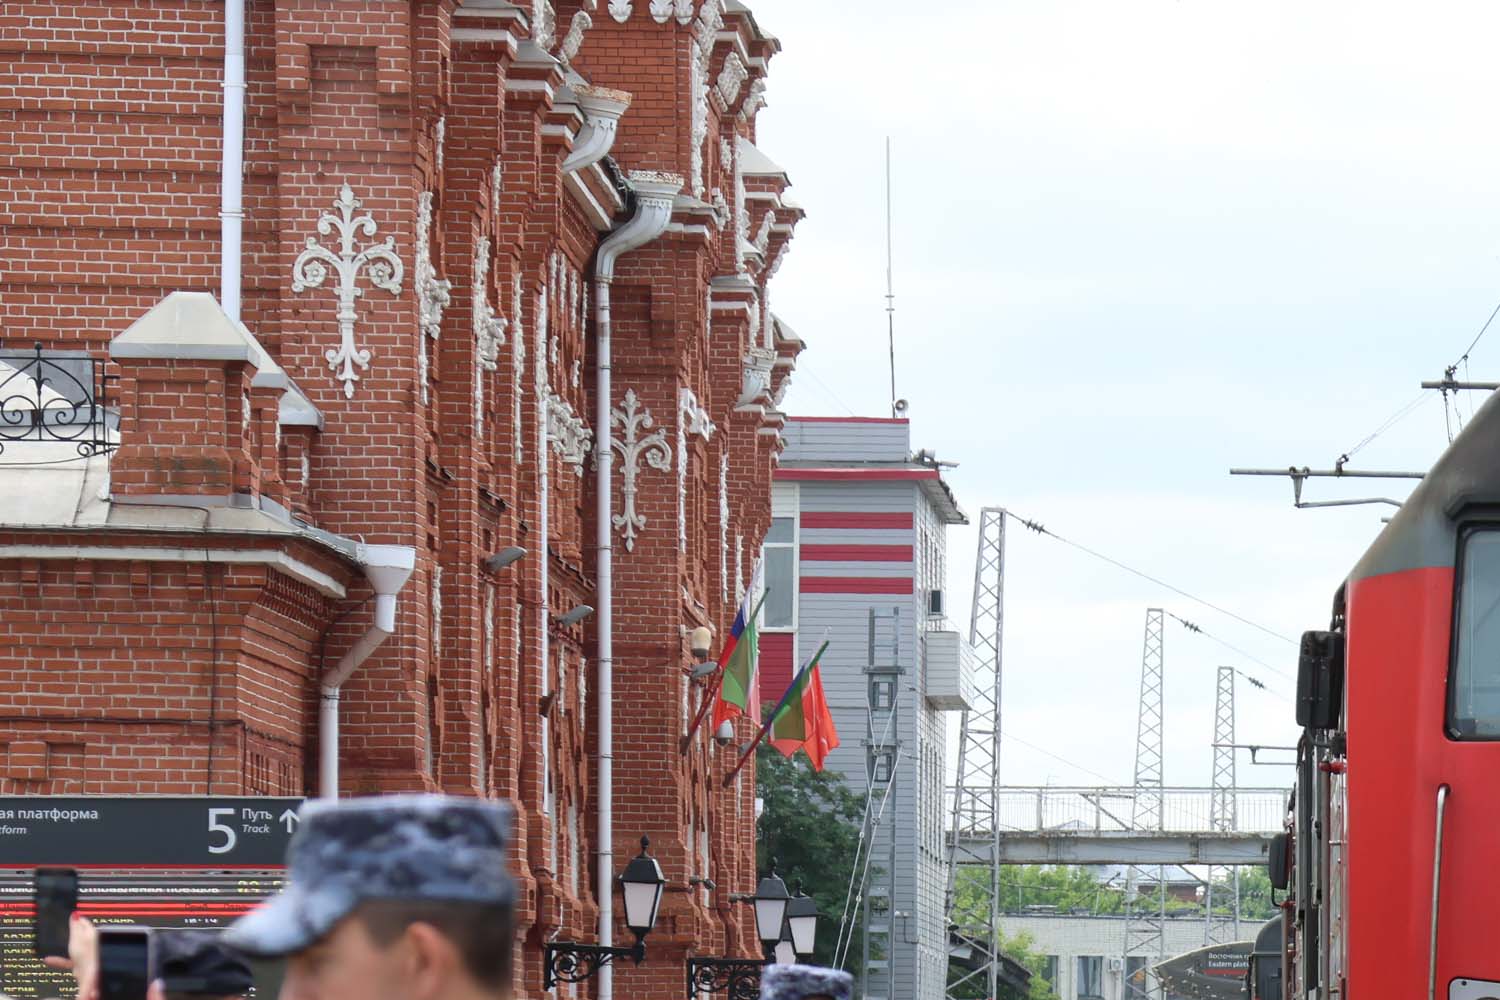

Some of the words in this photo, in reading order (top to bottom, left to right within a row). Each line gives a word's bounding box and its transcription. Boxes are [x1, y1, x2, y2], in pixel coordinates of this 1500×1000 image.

[18, 808, 98, 822] платформа
[242, 808, 273, 823] Путь
[208, 807, 236, 854] 5
[242, 824, 270, 833] Track
[1208, 960, 1232, 968] Eastern
